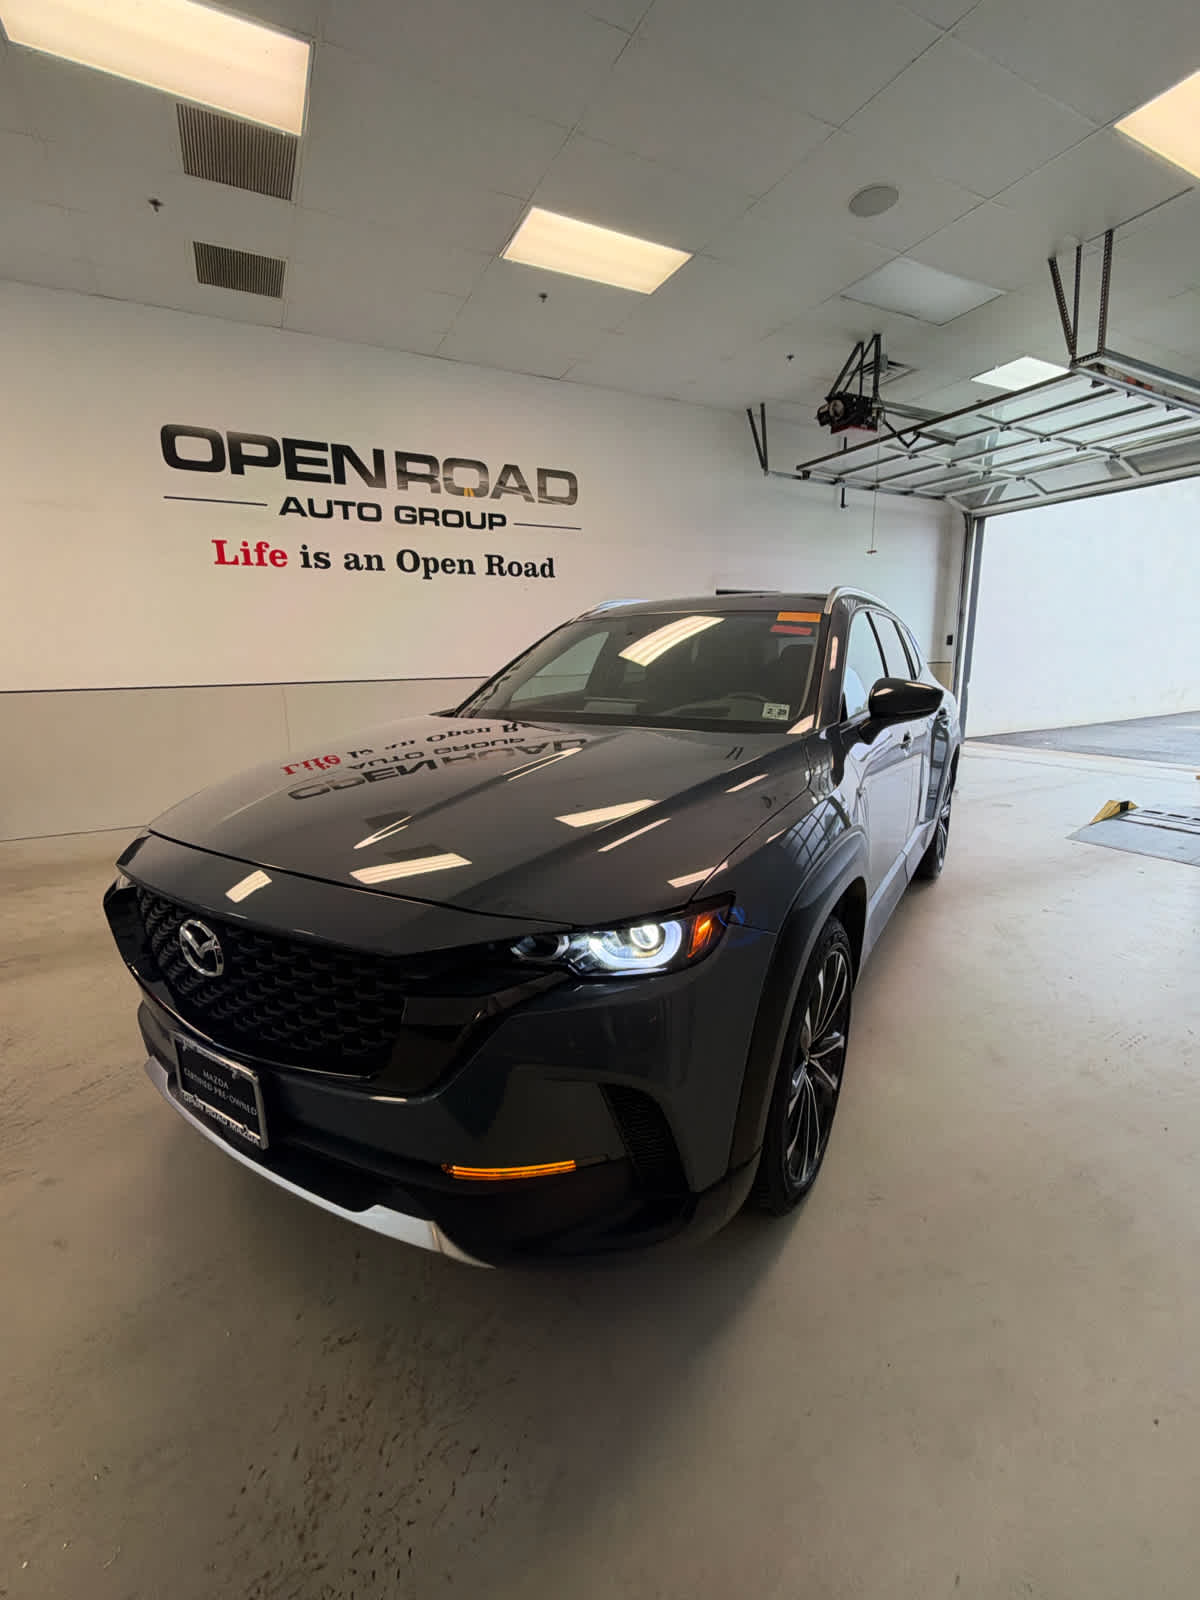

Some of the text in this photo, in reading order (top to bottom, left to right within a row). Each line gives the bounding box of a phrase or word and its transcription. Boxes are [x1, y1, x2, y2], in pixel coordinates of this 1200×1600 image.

[279, 496, 507, 529] AUTO GROUP
[211, 539, 555, 579] Life is an Open Road
[203, 1069, 229, 1089] MAZDA
